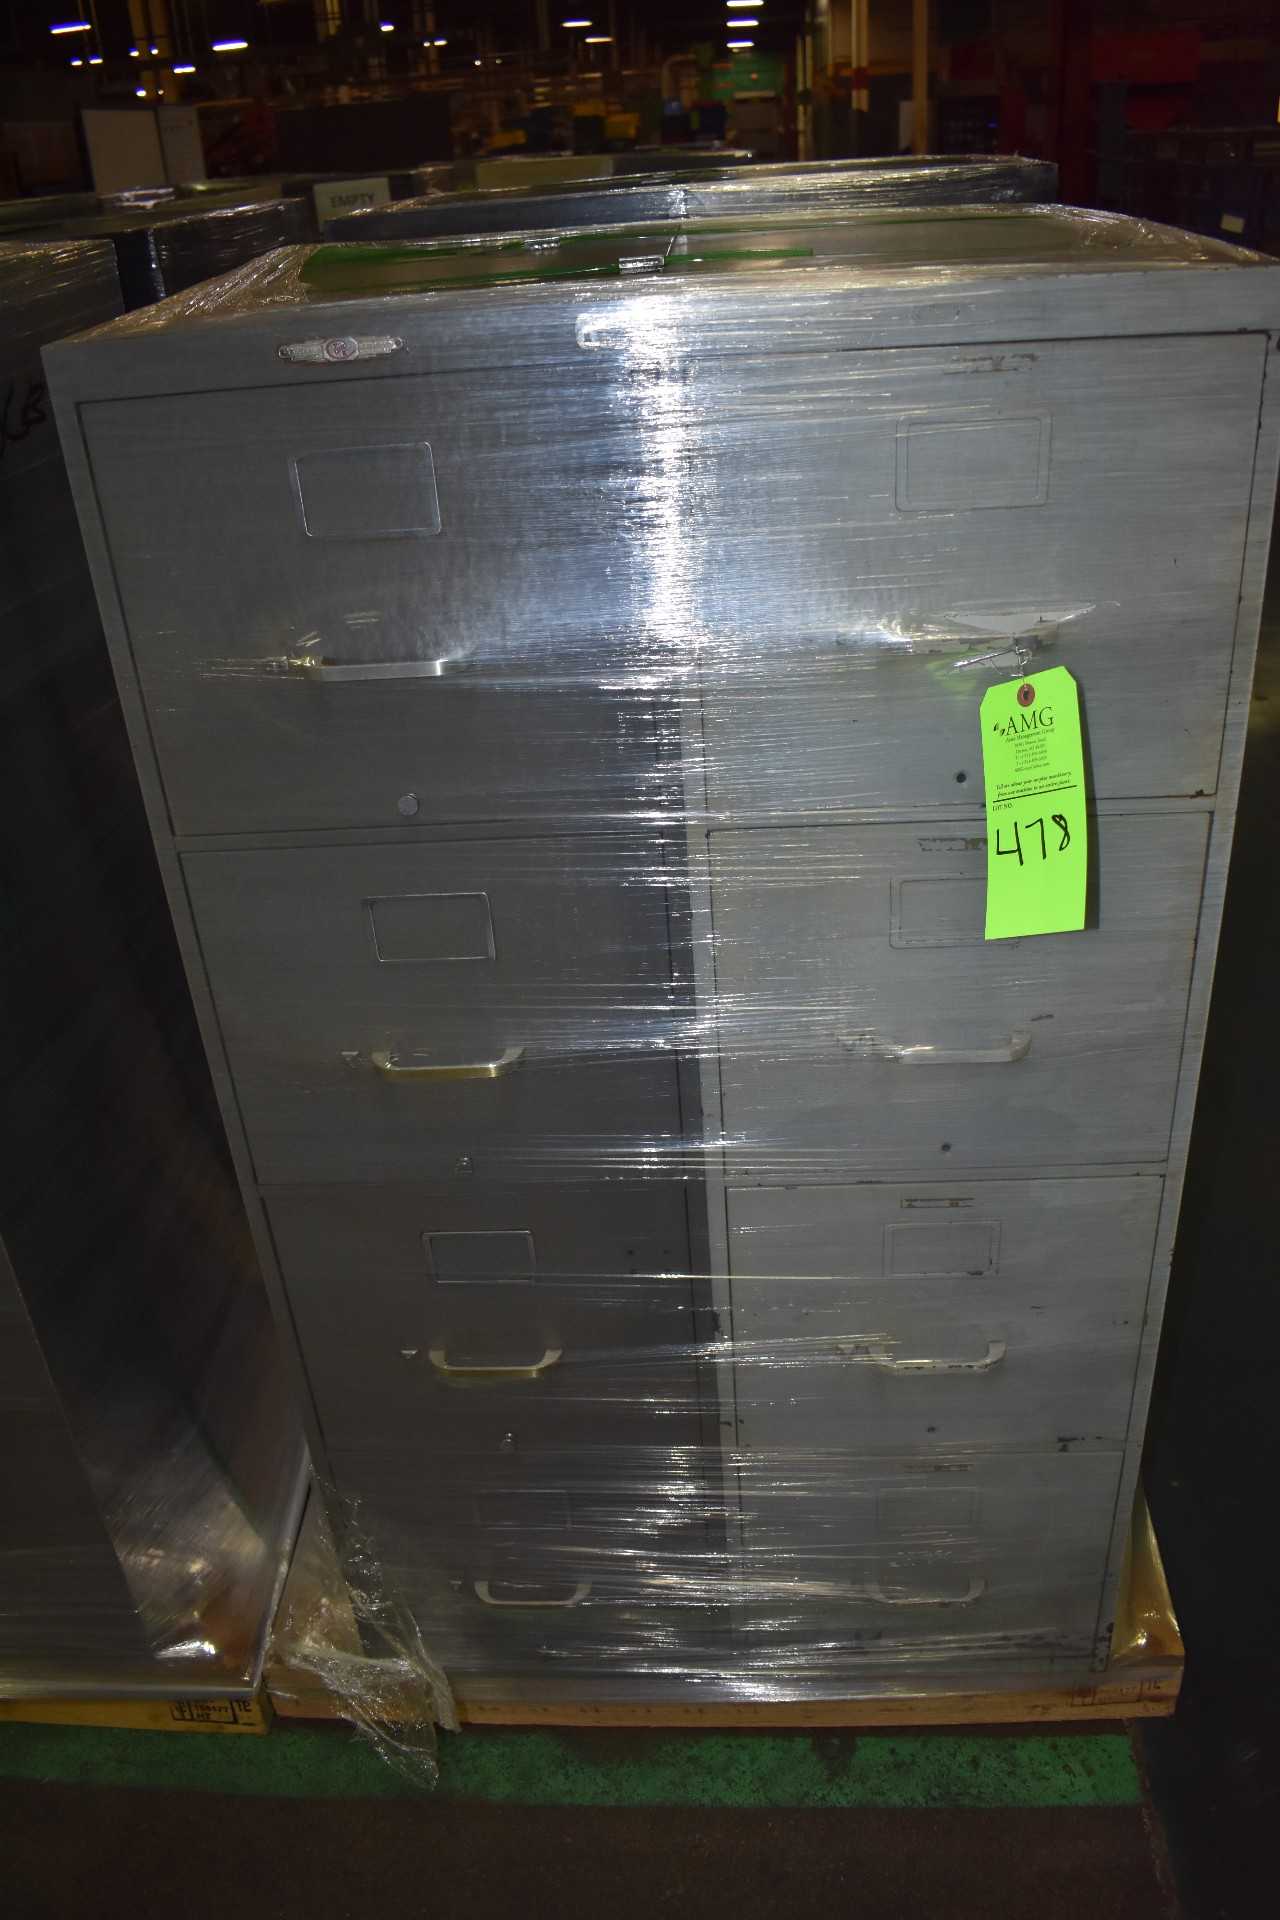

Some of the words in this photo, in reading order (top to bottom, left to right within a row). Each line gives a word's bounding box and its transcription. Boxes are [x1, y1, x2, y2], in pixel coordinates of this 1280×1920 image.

[330, 193, 376, 208] EMPTY
[1006, 706, 1054, 736] AMG
[996, 814, 1071, 866] 478
